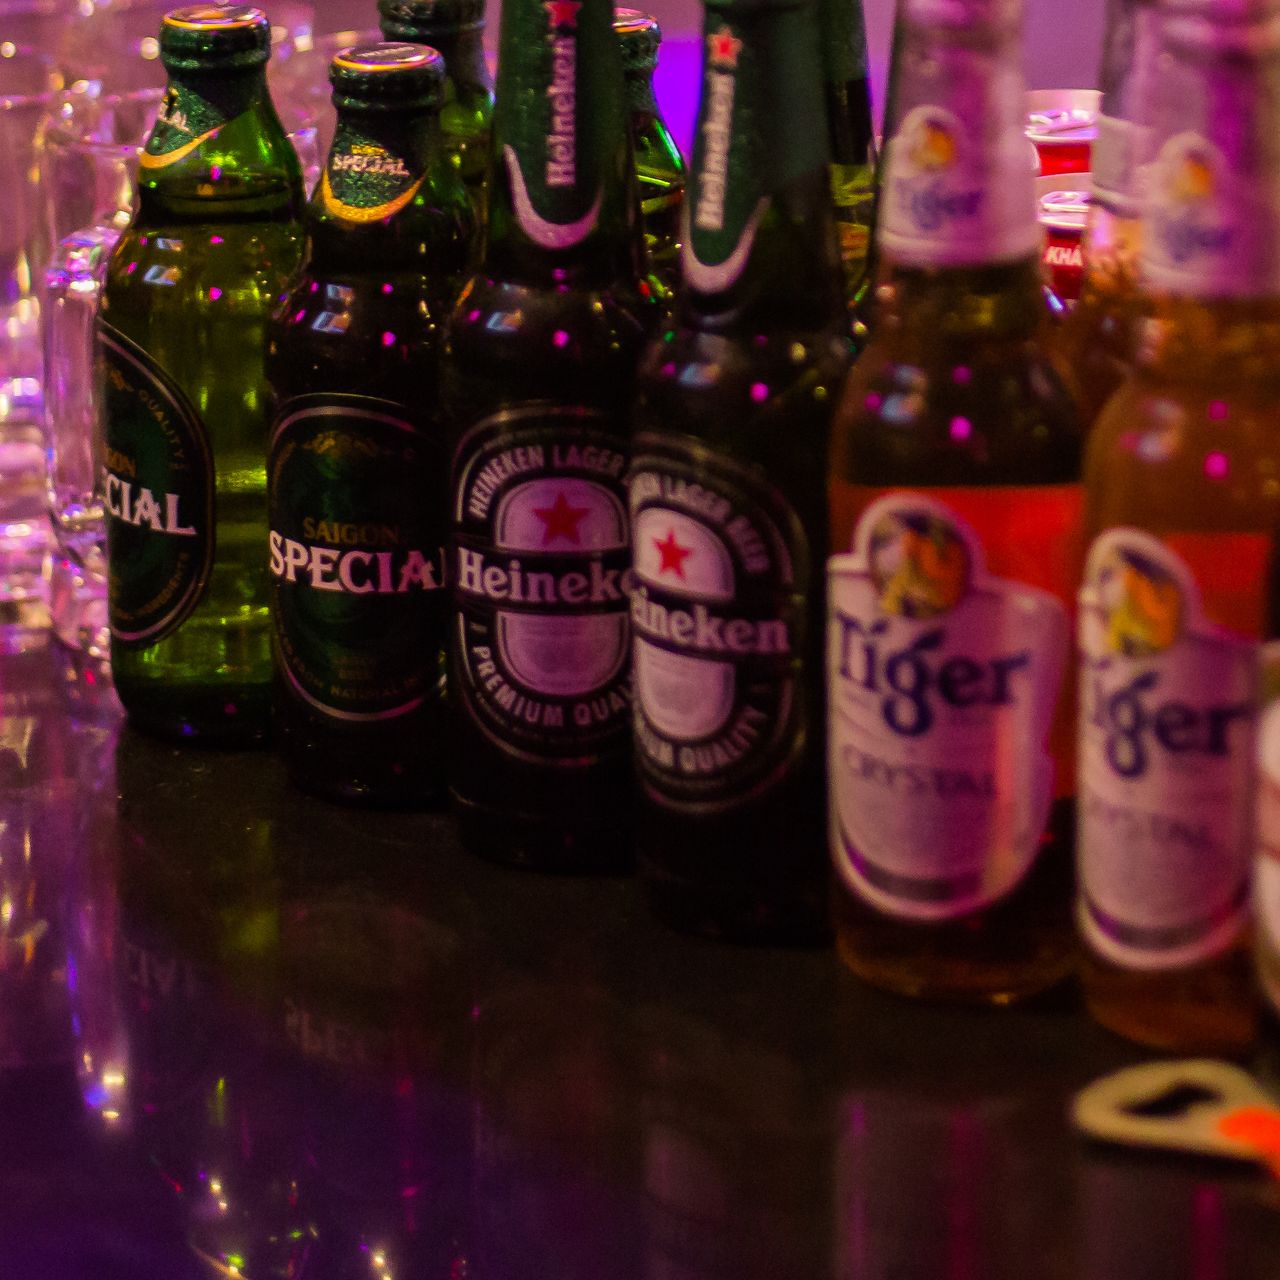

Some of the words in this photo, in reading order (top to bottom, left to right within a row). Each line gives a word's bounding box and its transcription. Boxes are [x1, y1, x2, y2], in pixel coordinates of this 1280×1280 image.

[544, 33, 578, 188] Heineken
[104, 467, 199, 536] CIAL
[469, 444, 546, 519] HEINEKEN
[552, 444, 624, 477] LAGER
[303, 517, 403, 546] SAIGON
[472, 644, 565, 727] PREMIUM
[836, 610, 1031, 738] Tiger
